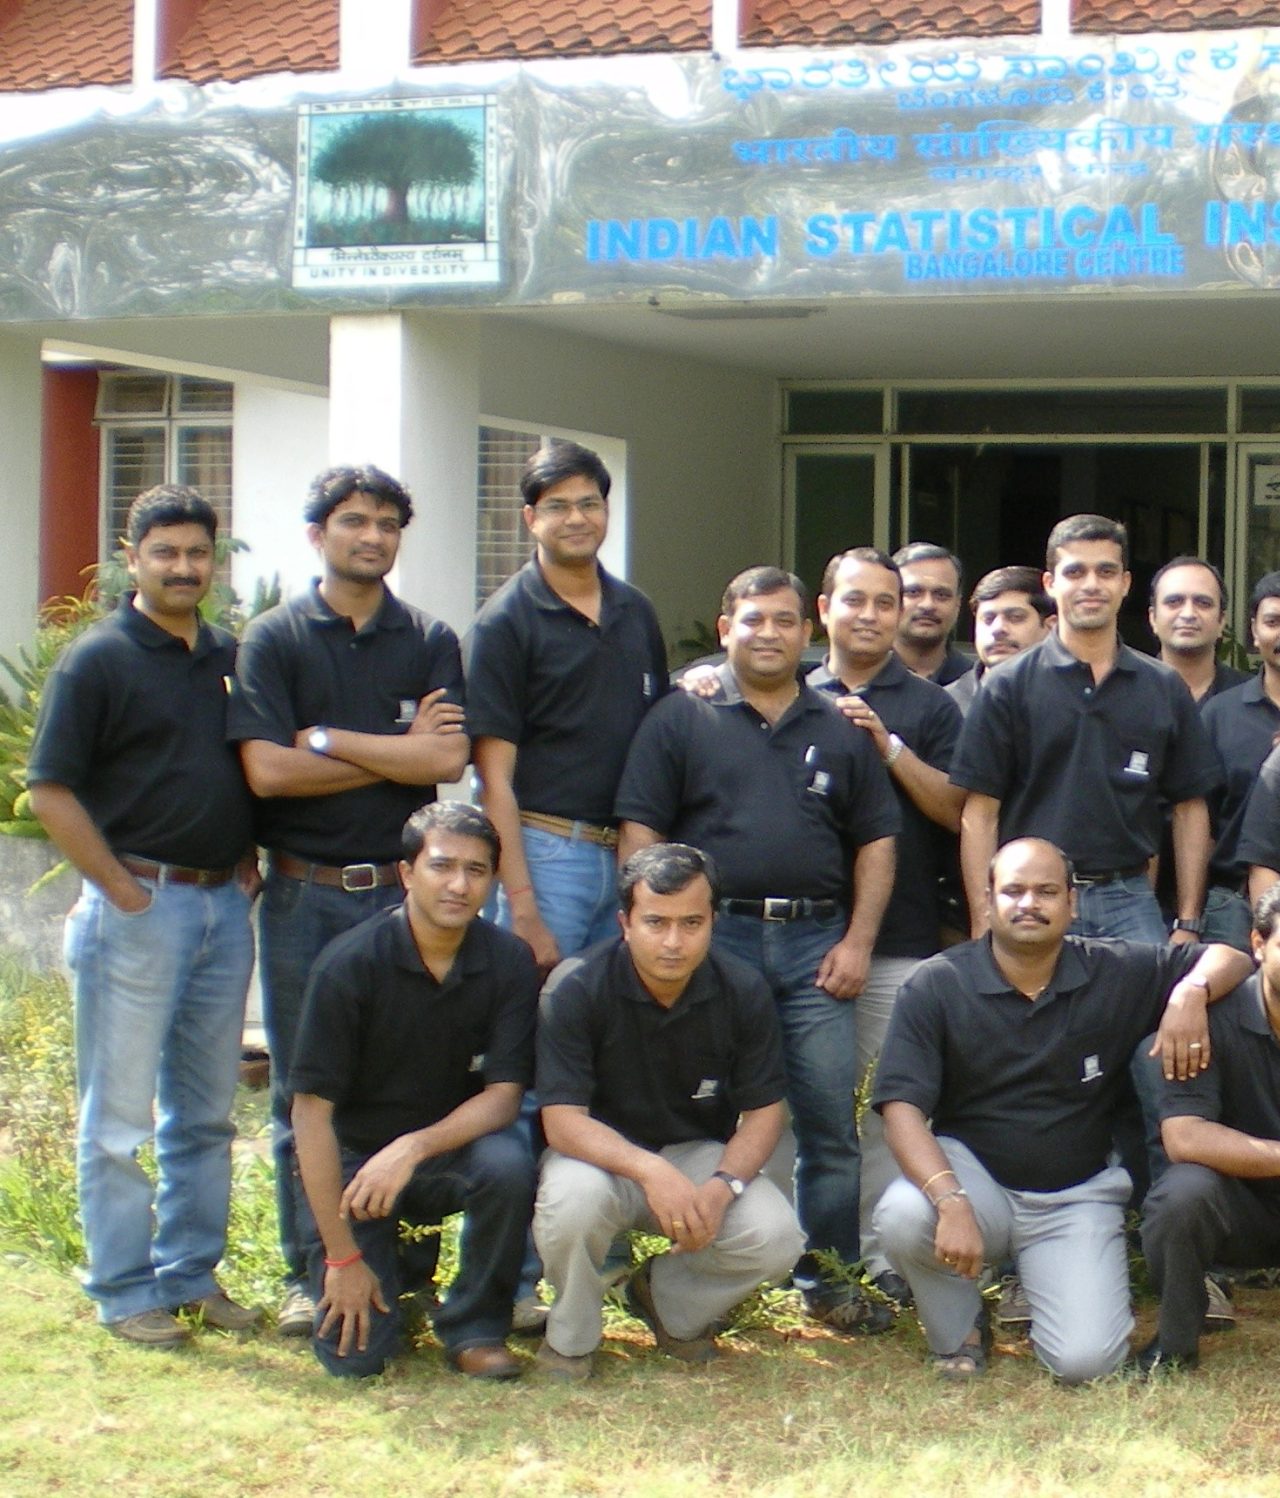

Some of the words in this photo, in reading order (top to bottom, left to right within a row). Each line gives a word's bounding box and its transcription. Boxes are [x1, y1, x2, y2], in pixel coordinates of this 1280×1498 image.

[721, 51, 982, 102] ಭಾರತೀಯ
[731, 127, 897, 165] भारतीय
[586, 214, 779, 264] INDIAN
[805, 201, 1177, 257] STATISTICAL
[310, 267, 356, 279] UNITY
[363, 266, 378, 277] IN
[383, 264, 470, 277] DIVERSITY
[905, 248, 1069, 281] BANGALORE
[1074, 245, 1186, 278] CENTRE
